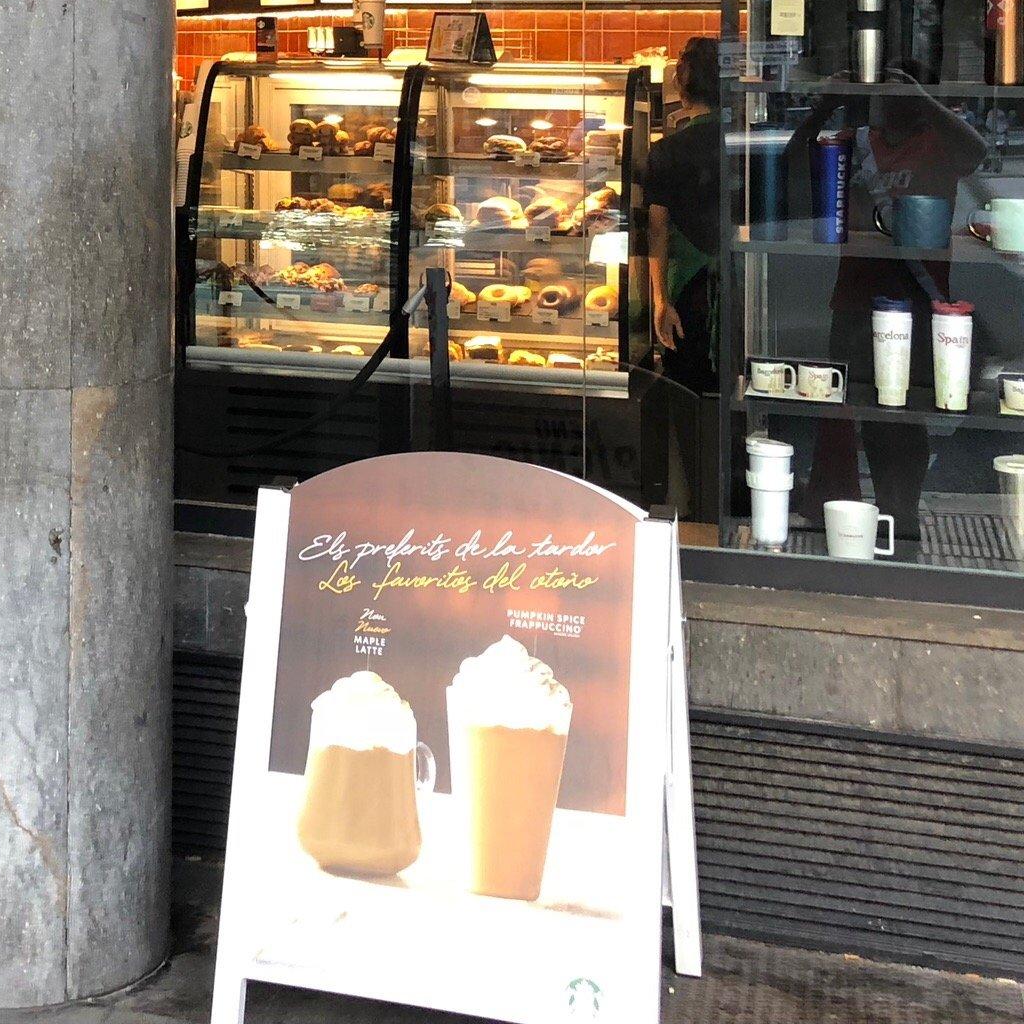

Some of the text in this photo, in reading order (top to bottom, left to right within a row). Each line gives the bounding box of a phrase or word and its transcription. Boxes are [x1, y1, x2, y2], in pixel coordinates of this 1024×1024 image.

[835, 154, 846, 234] STARBUCKS
[872, 329, 909, 342] arcelona
[937, 331, 969, 346] Spain
[298, 528, 617, 570] Els preferits de la tardor
[318, 559, 600, 601] Los favoritos del otoño
[506, 608, 586, 625] PUMPKIN SPICE
[509, 618, 582, 634] FRAPPUCCINO
[353, 635, 386, 647] MAPLE
[355, 644, 383, 656] LATTE
